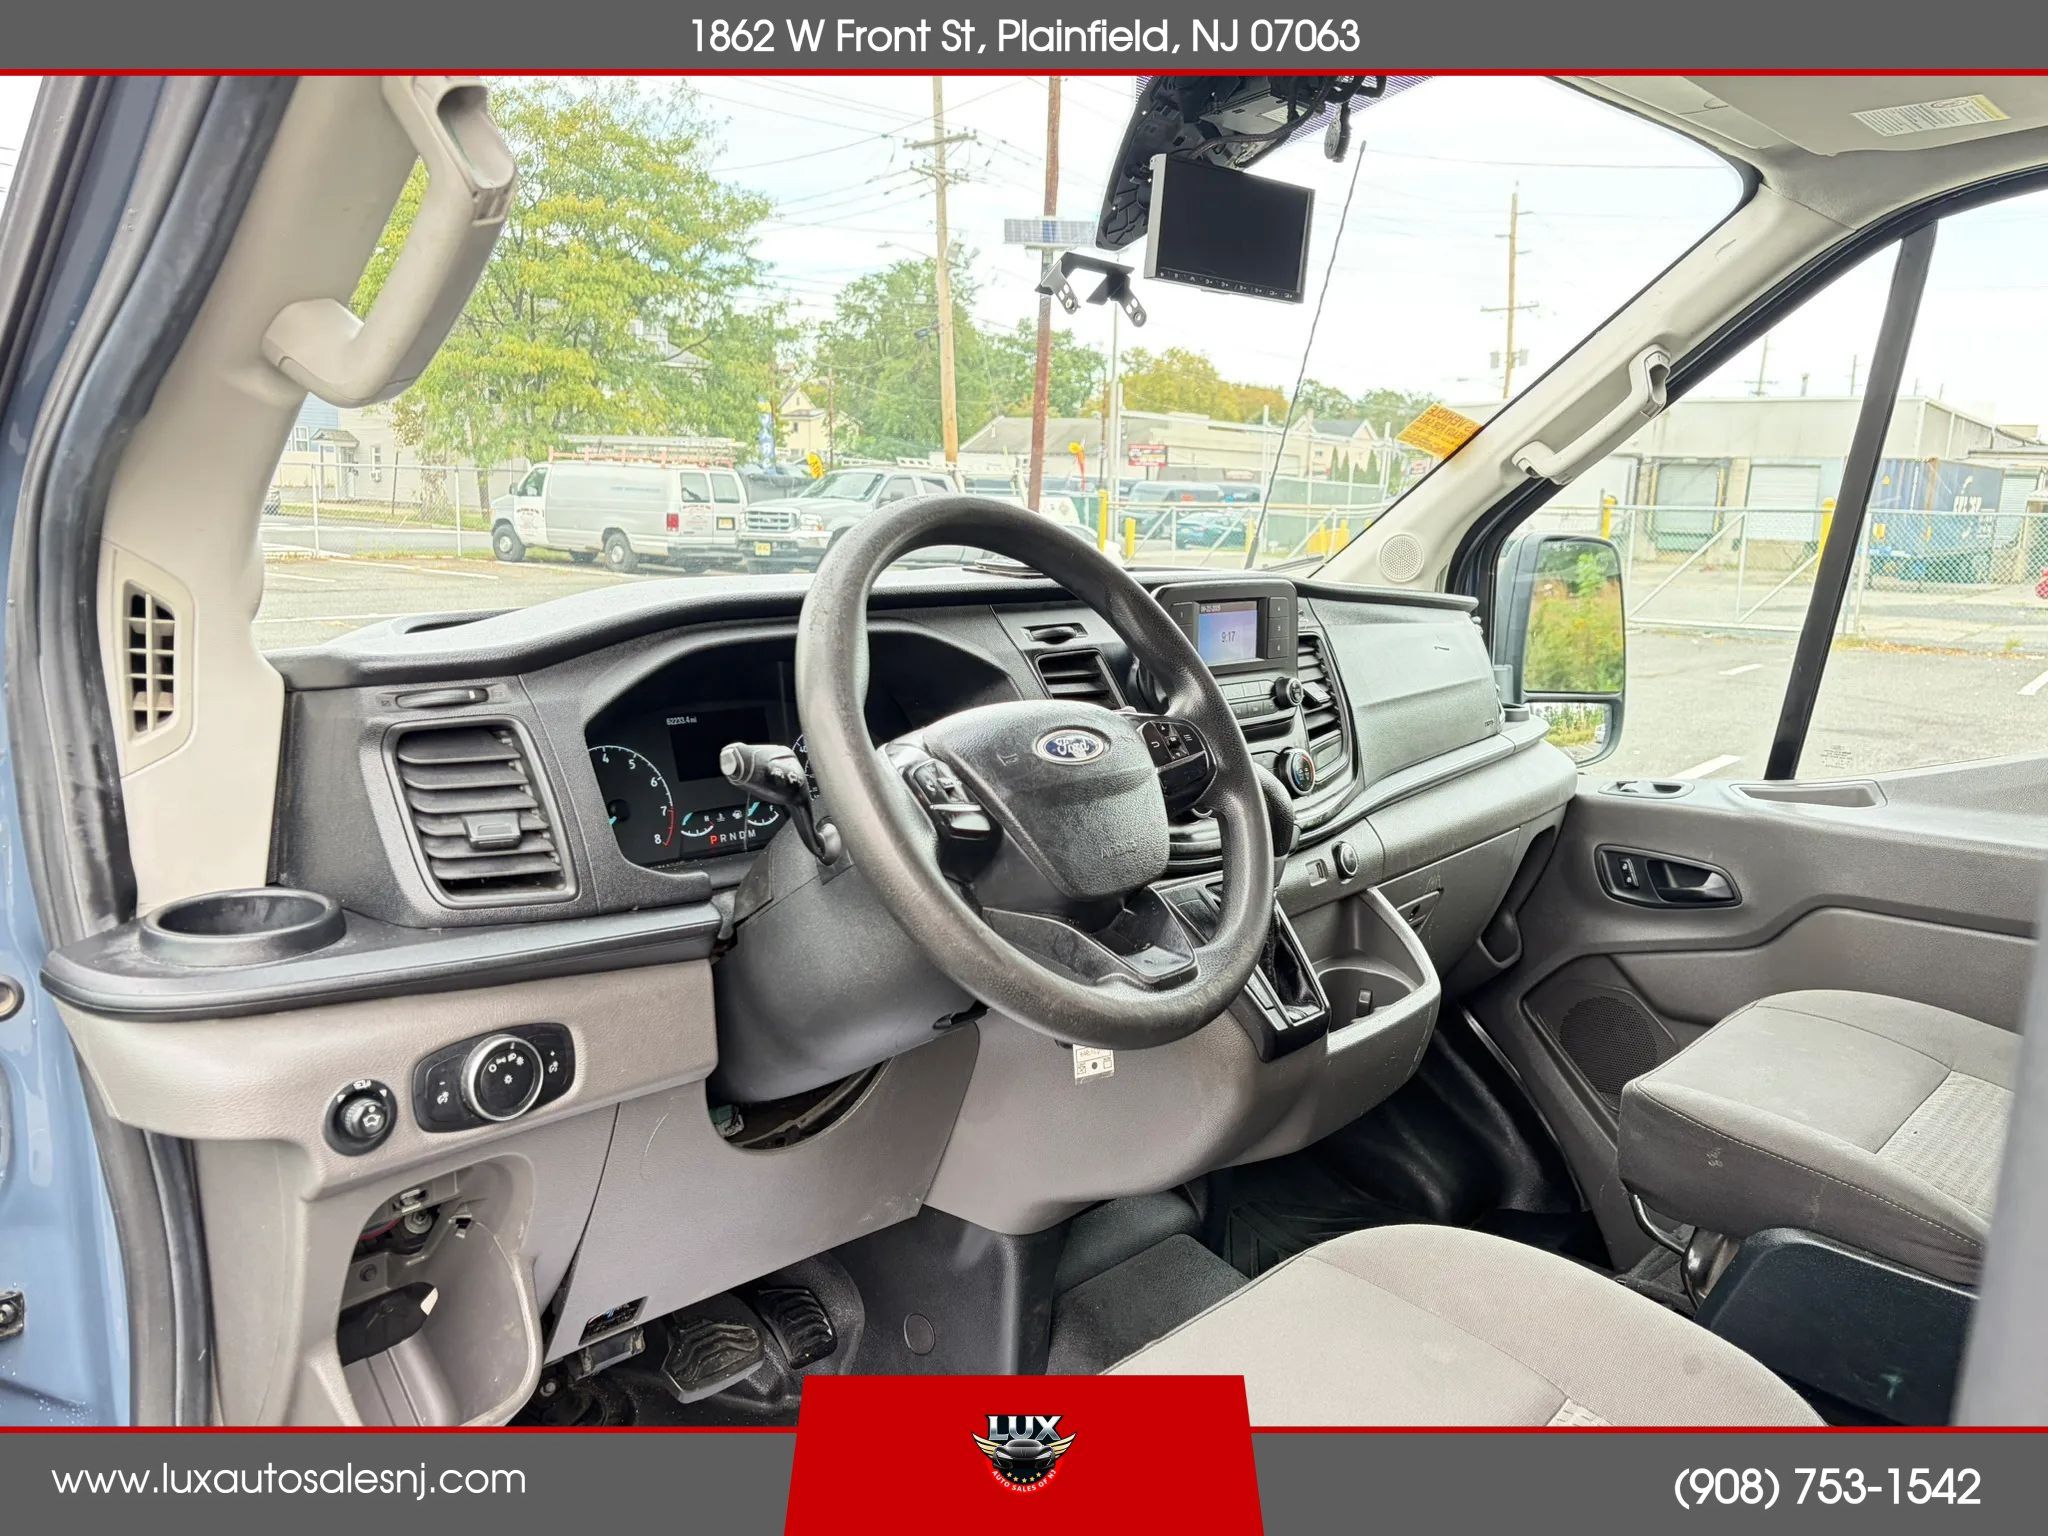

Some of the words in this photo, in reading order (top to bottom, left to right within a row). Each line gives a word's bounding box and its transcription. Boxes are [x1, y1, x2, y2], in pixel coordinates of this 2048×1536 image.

[1221, 631, 1236, 643] 9:17
[666, 715, 691, 726] 62233.4
[1055, 736, 1091, 757] Ford
[602, 753, 610, 764] 4
[628, 759, 636, 770] 5
[650, 777, 659, 787] 6
[660, 805, 668, 817] 7
[654, 834, 662, 845] 8
[709, 835, 718, 845] P
[720, 834, 727, 843] R
[729, 832, 736, 842] N
[748, 830, 756, 838] M
